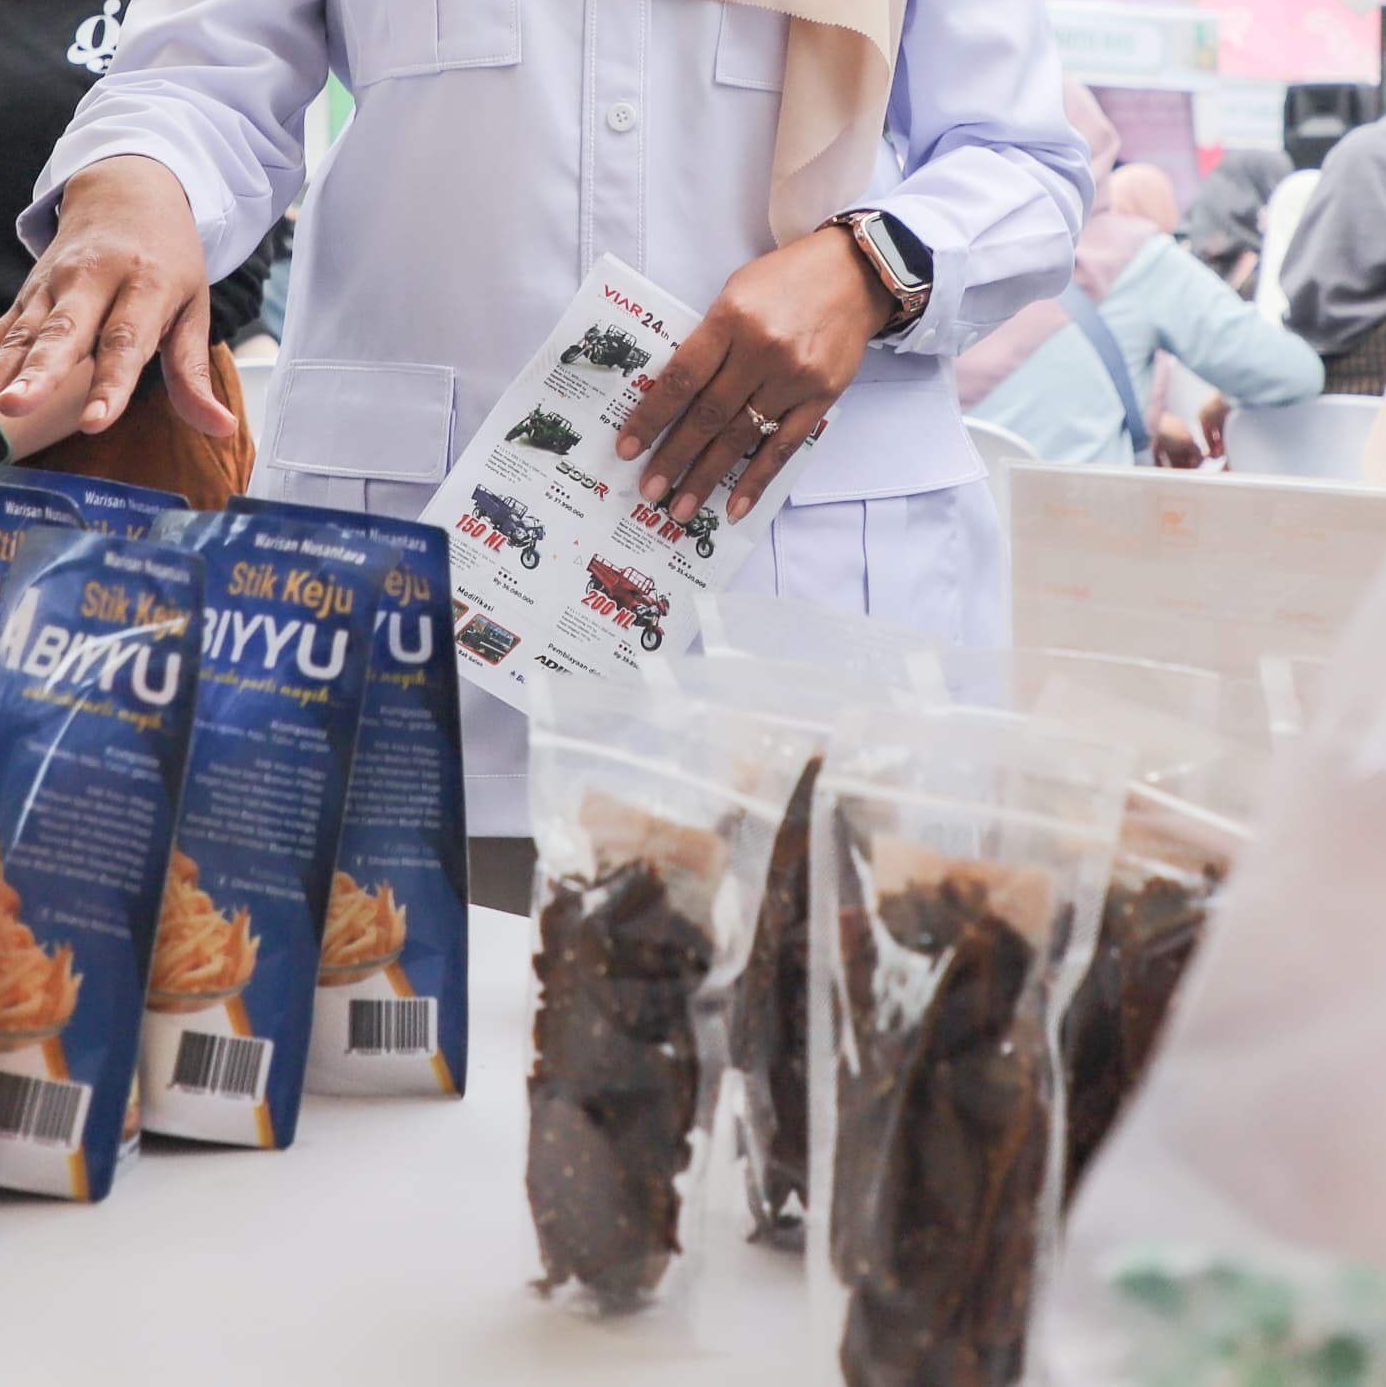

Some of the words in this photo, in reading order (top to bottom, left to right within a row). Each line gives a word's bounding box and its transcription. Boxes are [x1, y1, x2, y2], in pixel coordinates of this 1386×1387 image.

[603, 283, 644, 317] VIAR
[4, 499, 44, 519] Warisan
[84, 490, 126, 509] Warisan
[455, 513, 488, 539] 150
[482, 528, 508, 554] NL
[630, 503, 662, 528] 150
[657, 519, 687, 545] RN
[253, 531, 299, 553] Warisan
[299, 537, 367, 566] Nusantara
[82, 580, 132, 624] Stik
[228, 561, 279, 600] Stik
[282, 568, 355, 620] Keju
[383, 567, 432, 608] eju
[456, 585, 496, 613] Modifikasi
[580, 588, 616, 616] 200
[612, 607, 638, 631] NL
[201, 607, 350, 681] BIYYU
[547, 641, 589, 672] Pembiayaan
